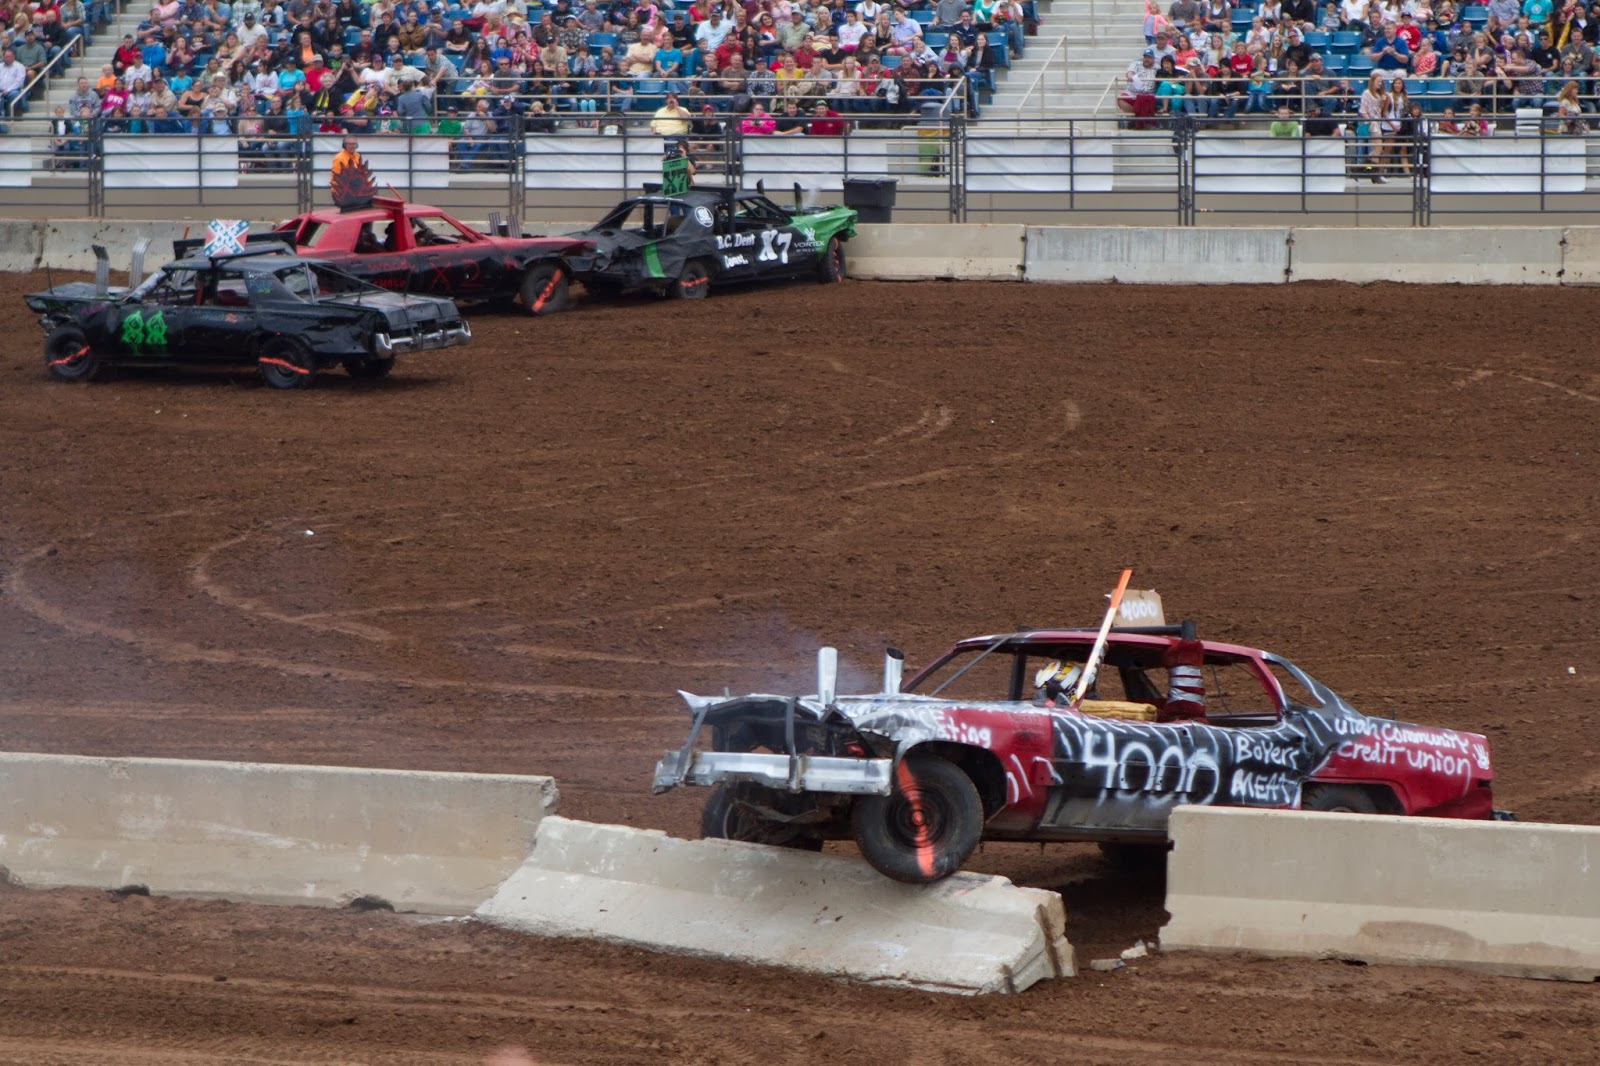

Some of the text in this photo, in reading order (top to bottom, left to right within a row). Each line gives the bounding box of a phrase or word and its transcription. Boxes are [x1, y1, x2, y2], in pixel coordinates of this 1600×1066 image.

[663, 167, 689, 196] X7
[759, 229, 793, 265] X7
[794, 240, 826, 250] VORTEX
[1082, 729, 1220, 806] 4000
